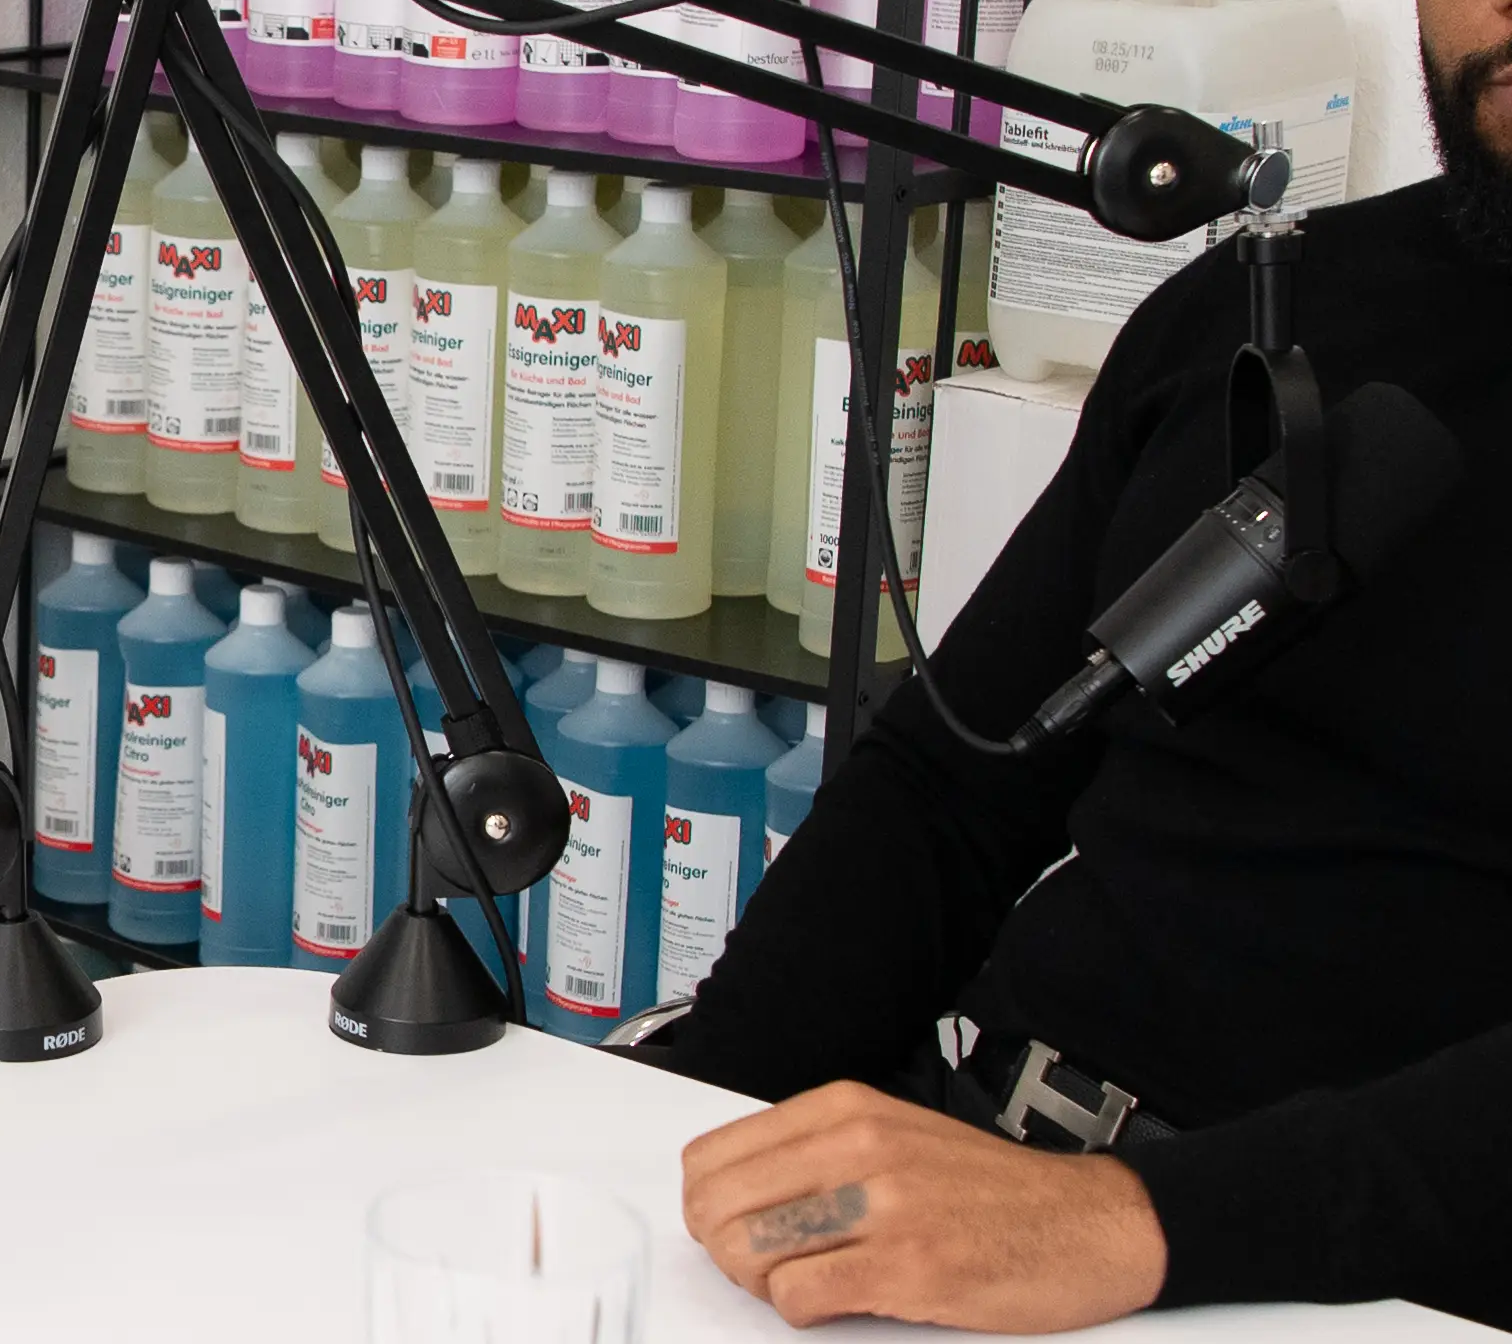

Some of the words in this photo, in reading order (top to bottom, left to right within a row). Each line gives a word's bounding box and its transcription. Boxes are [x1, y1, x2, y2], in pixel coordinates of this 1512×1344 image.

[746, 52, 789, 66] bestfour
[1004, 121, 1049, 141] Tablefit
[158, 239, 222, 281] MAXI
[353, 276, 388, 310] XI
[515, 302, 587, 345] MAXI
[507, 342, 597, 372] Essigreiniger
[547, 374, 565, 386] und
[568, 375, 587, 387] Bad
[597, 363, 654, 388] greiniger
[894, 354, 932, 397] AXI
[578, 392, 596, 400] wasse
[625, 392, 642, 406] Bad
[1165, 598, 1267, 689] SHURE
[126, 694, 172, 727] AXI
[569, 790, 591, 823] XI
[664, 814, 692, 846] XI
[43, 1026, 86, 1051] RØDE
[334, 1010, 369, 1039] RØDE
